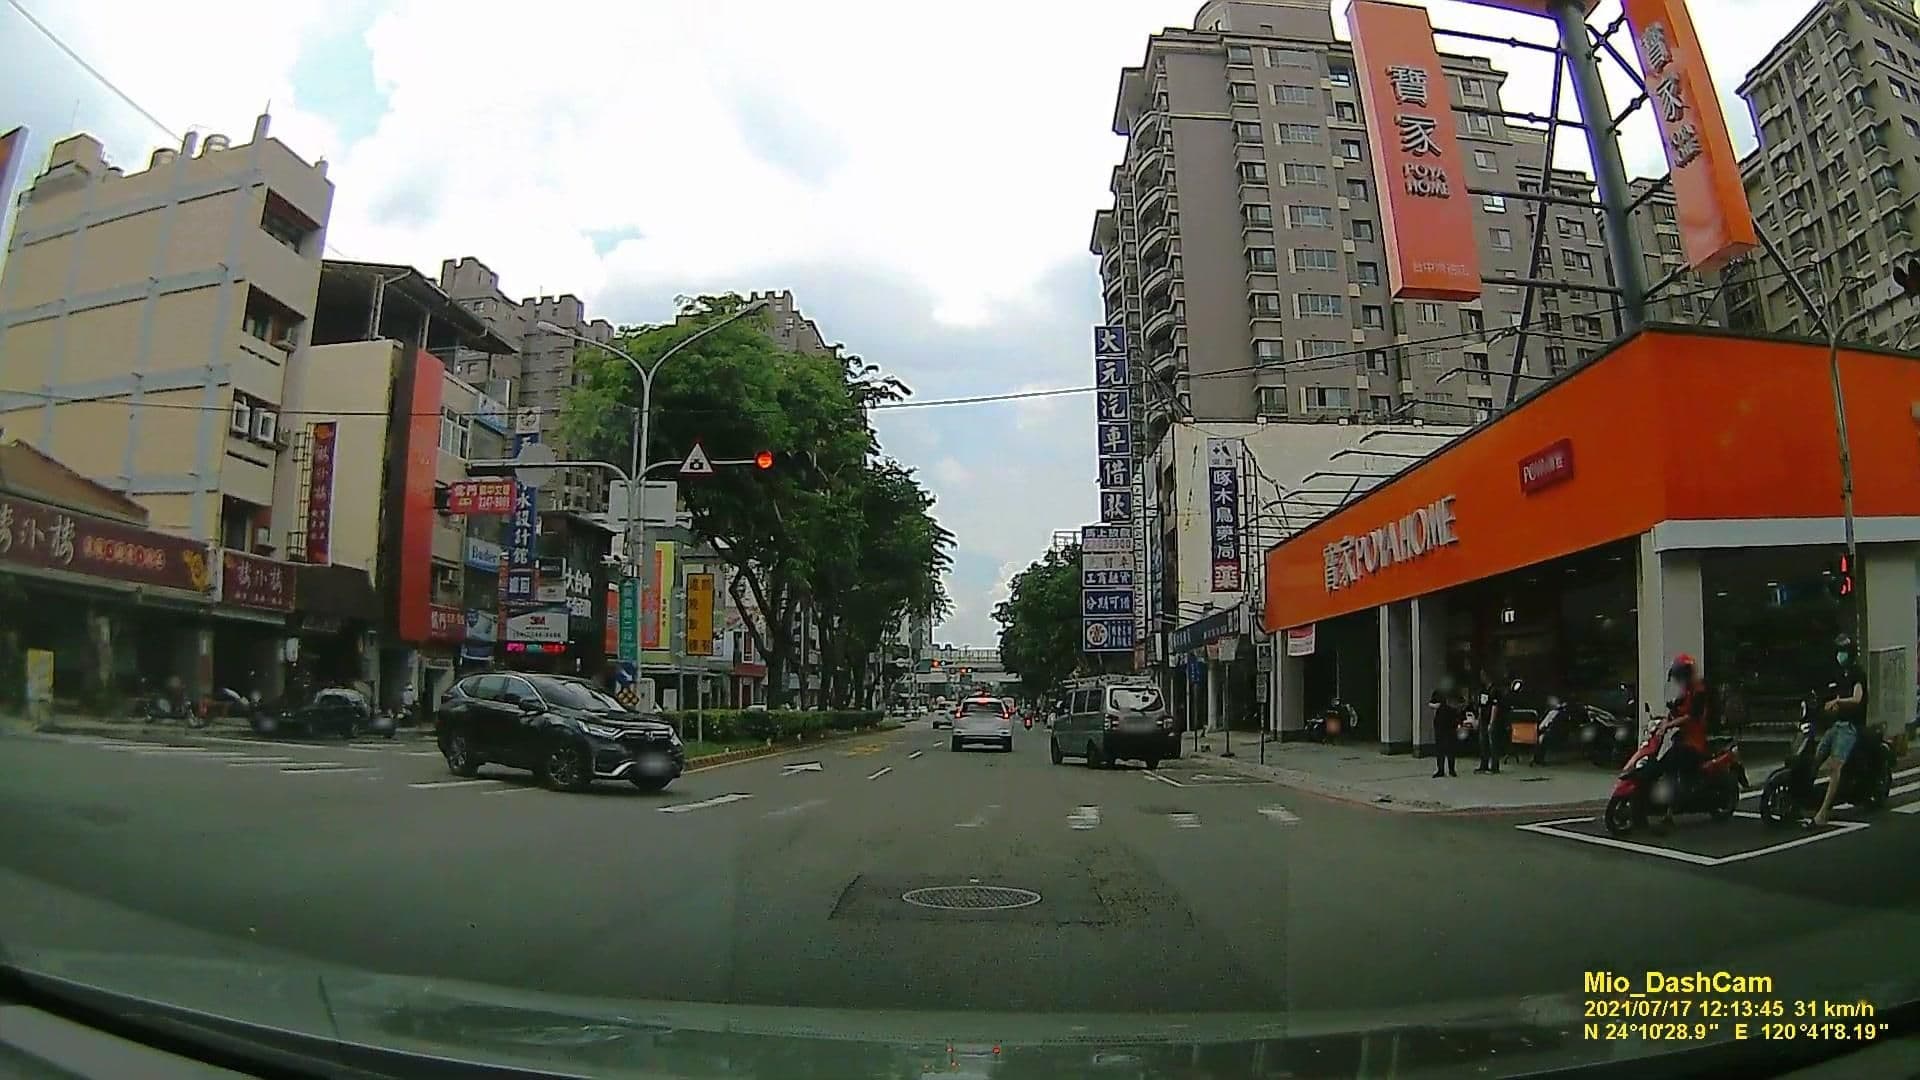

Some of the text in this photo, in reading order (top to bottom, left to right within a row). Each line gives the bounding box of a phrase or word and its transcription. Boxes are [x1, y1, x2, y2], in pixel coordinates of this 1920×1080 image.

[1386, 65, 1441, 157] 寶家
[1403, 162, 1448, 182] POYA
[1405, 179, 1450, 199] HOME
[513, 485, 532, 564] 水設計館
[1213, 470, 1235, 560] 啄木鳥藥局
[529, 616, 546, 626] 3M
